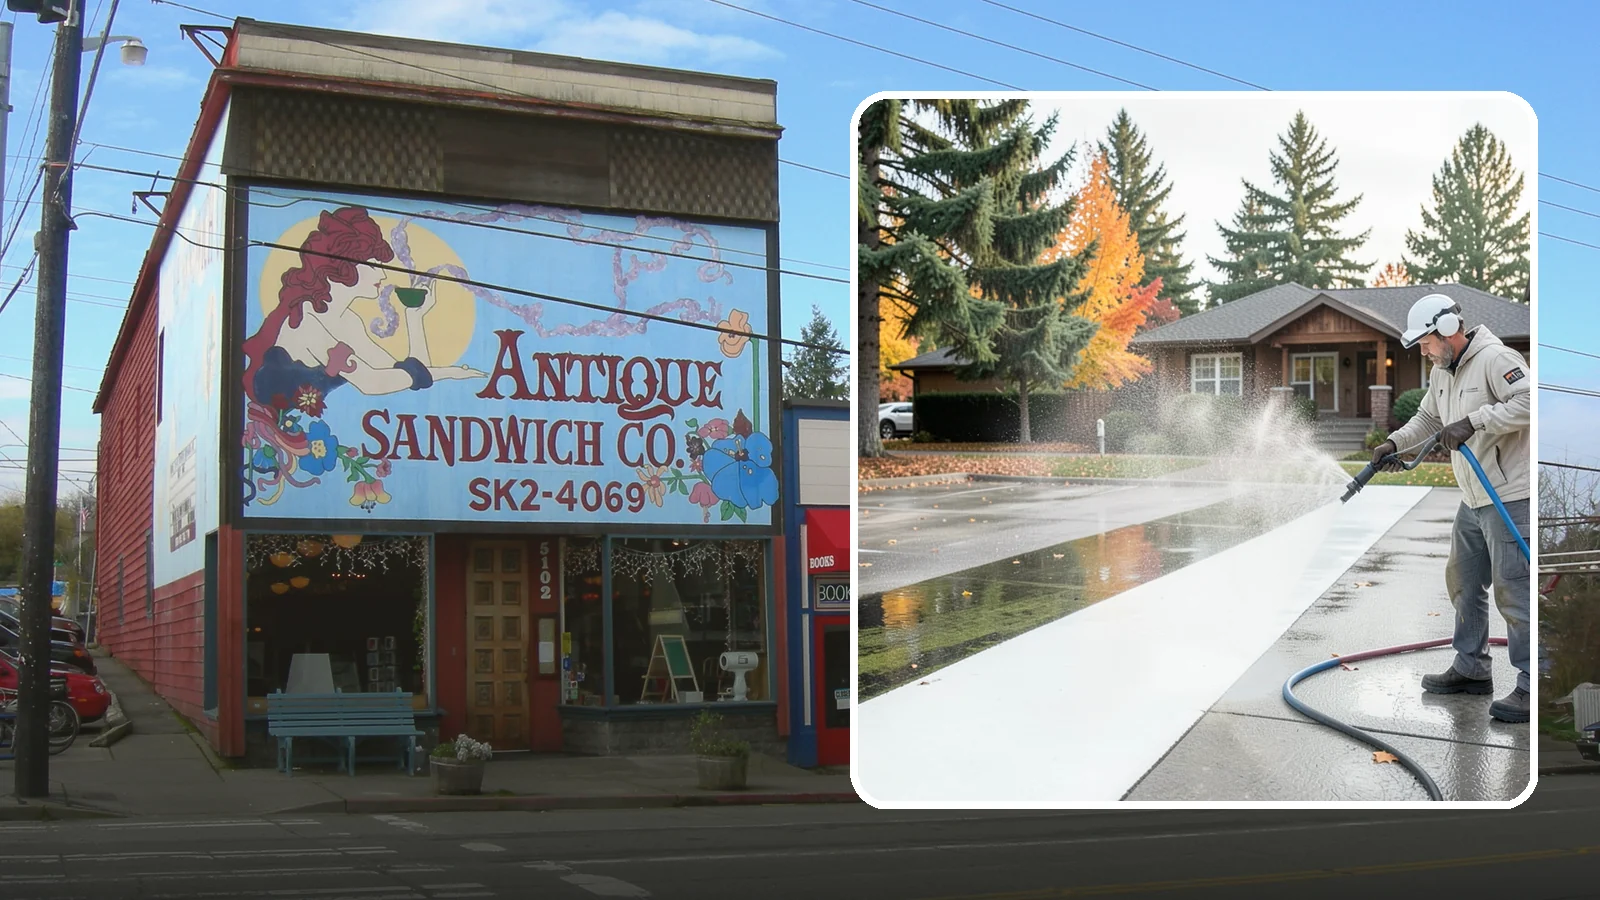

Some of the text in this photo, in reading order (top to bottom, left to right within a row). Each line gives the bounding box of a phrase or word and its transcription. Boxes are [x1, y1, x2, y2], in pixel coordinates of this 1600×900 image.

[477, 329, 723, 421] ANTIQUE
[362, 409, 686, 469] SANDWICH CO.
[468, 477, 647, 513] SK2-4069
[540, 541, 552, 599] 5102
[809, 554, 835, 569] BOOKS
